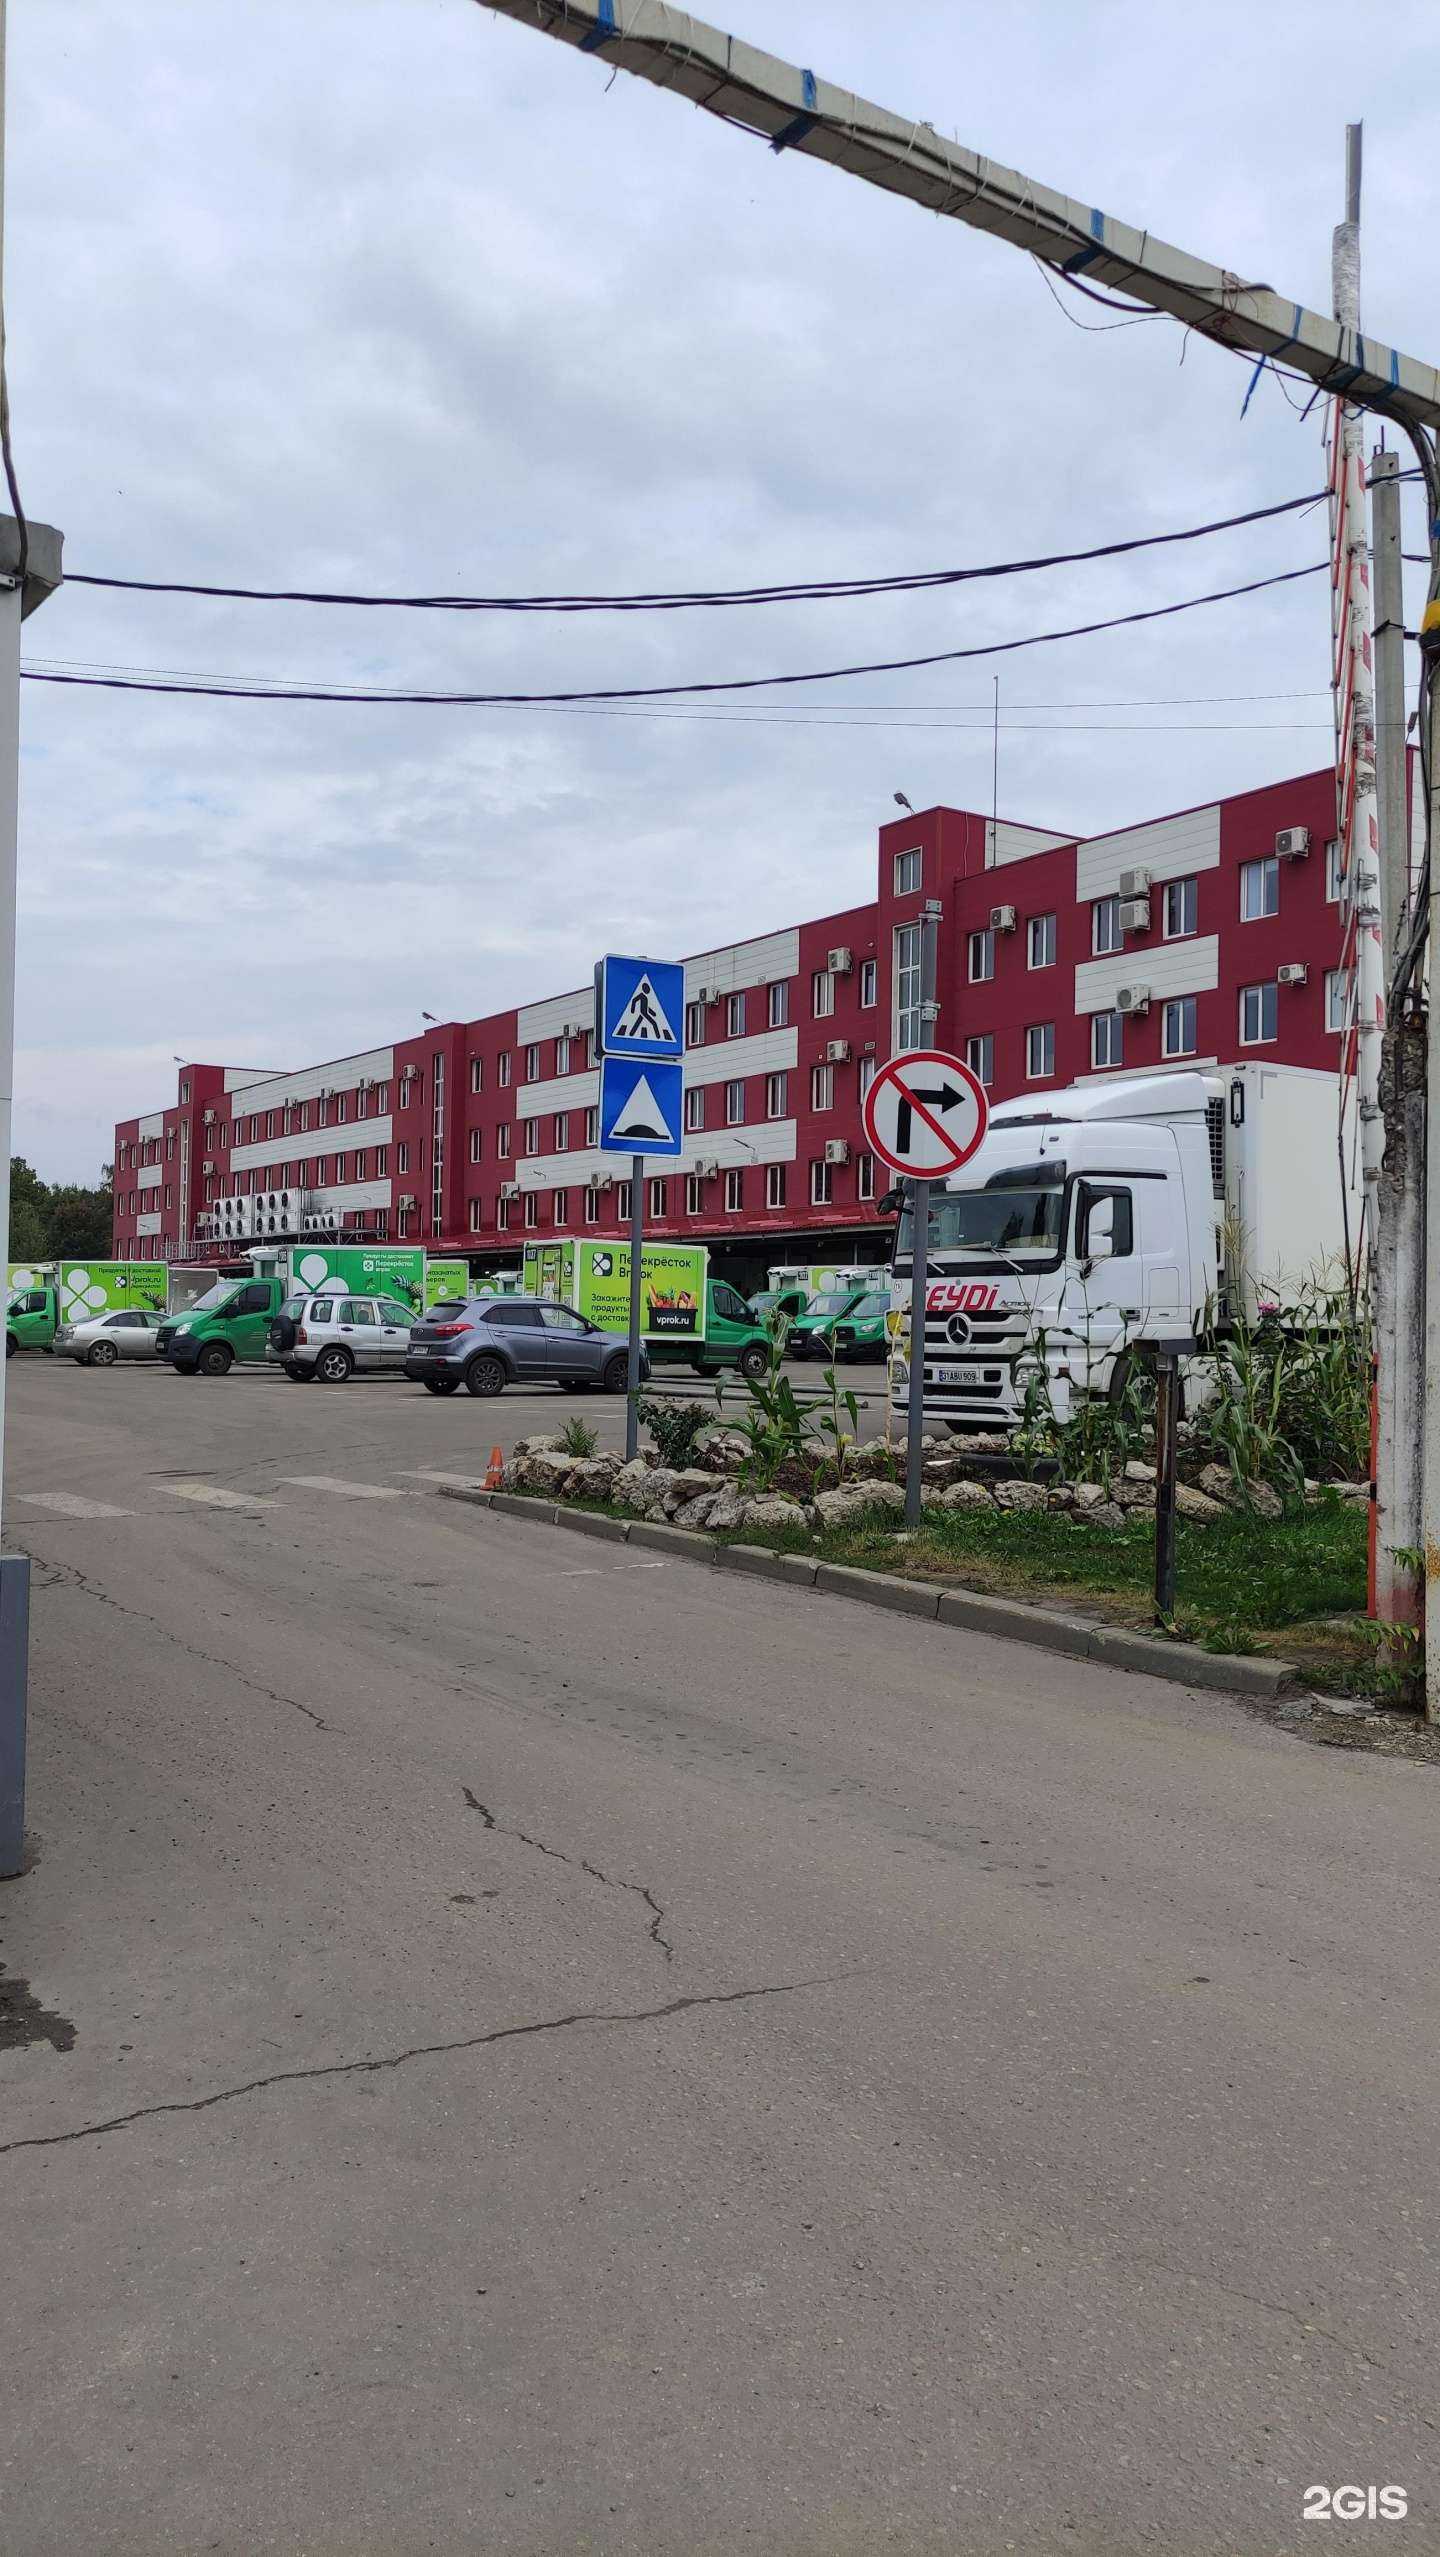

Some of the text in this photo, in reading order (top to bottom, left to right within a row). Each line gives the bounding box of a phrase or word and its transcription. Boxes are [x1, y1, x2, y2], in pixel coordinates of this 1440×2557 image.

[619, 1253, 692, 1269] Пеекрёсток
[619, 1267, 653, 1279] Впок
[598, 1314, 630, 1323] доставк
[656, 1316, 690, 1326] vprok.ru
